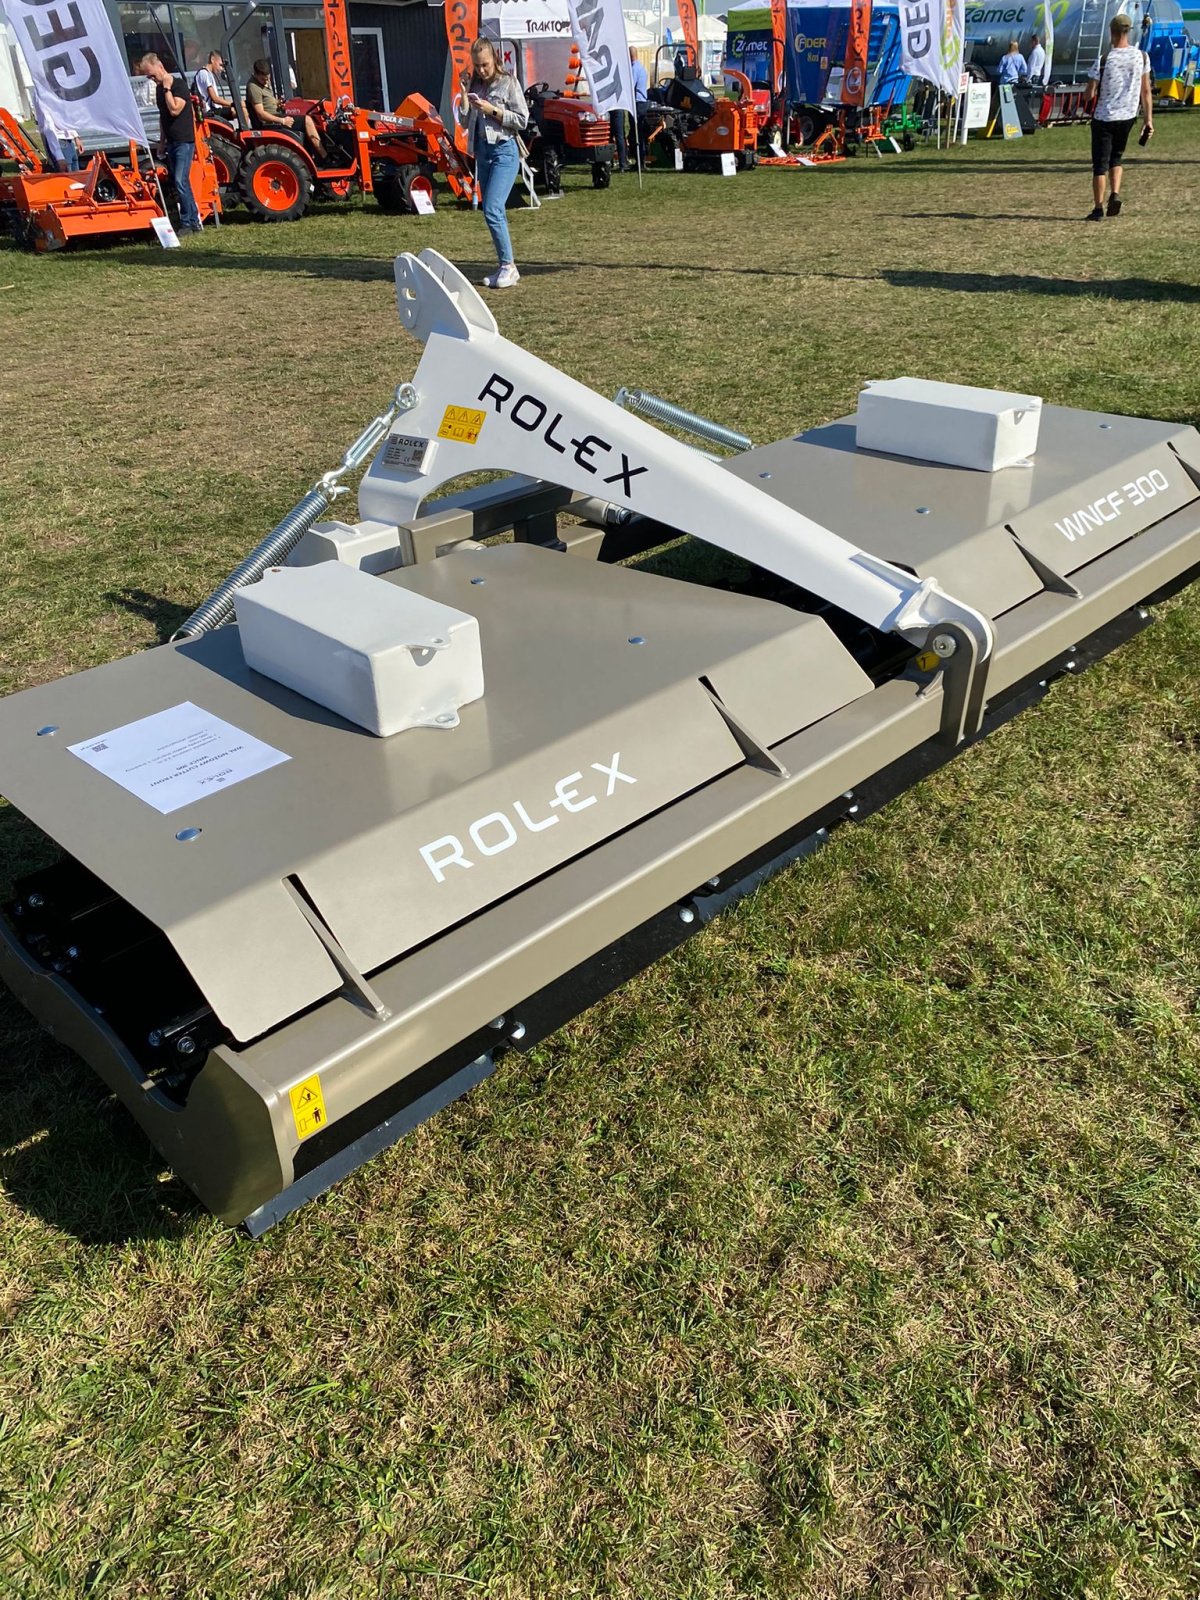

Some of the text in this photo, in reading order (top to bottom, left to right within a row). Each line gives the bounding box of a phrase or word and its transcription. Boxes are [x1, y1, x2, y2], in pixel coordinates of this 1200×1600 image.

[23, 0, 102, 101] GE
[905, 0, 931, 59] GE
[965, 6, 1025, 23] Zamet
[398, 438, 425, 448] ROLEX
[477, 372, 649, 499] ROLEX
[1054, 469, 1169, 543] WNCF 300
[418, 751, 638, 883] ROLEX
